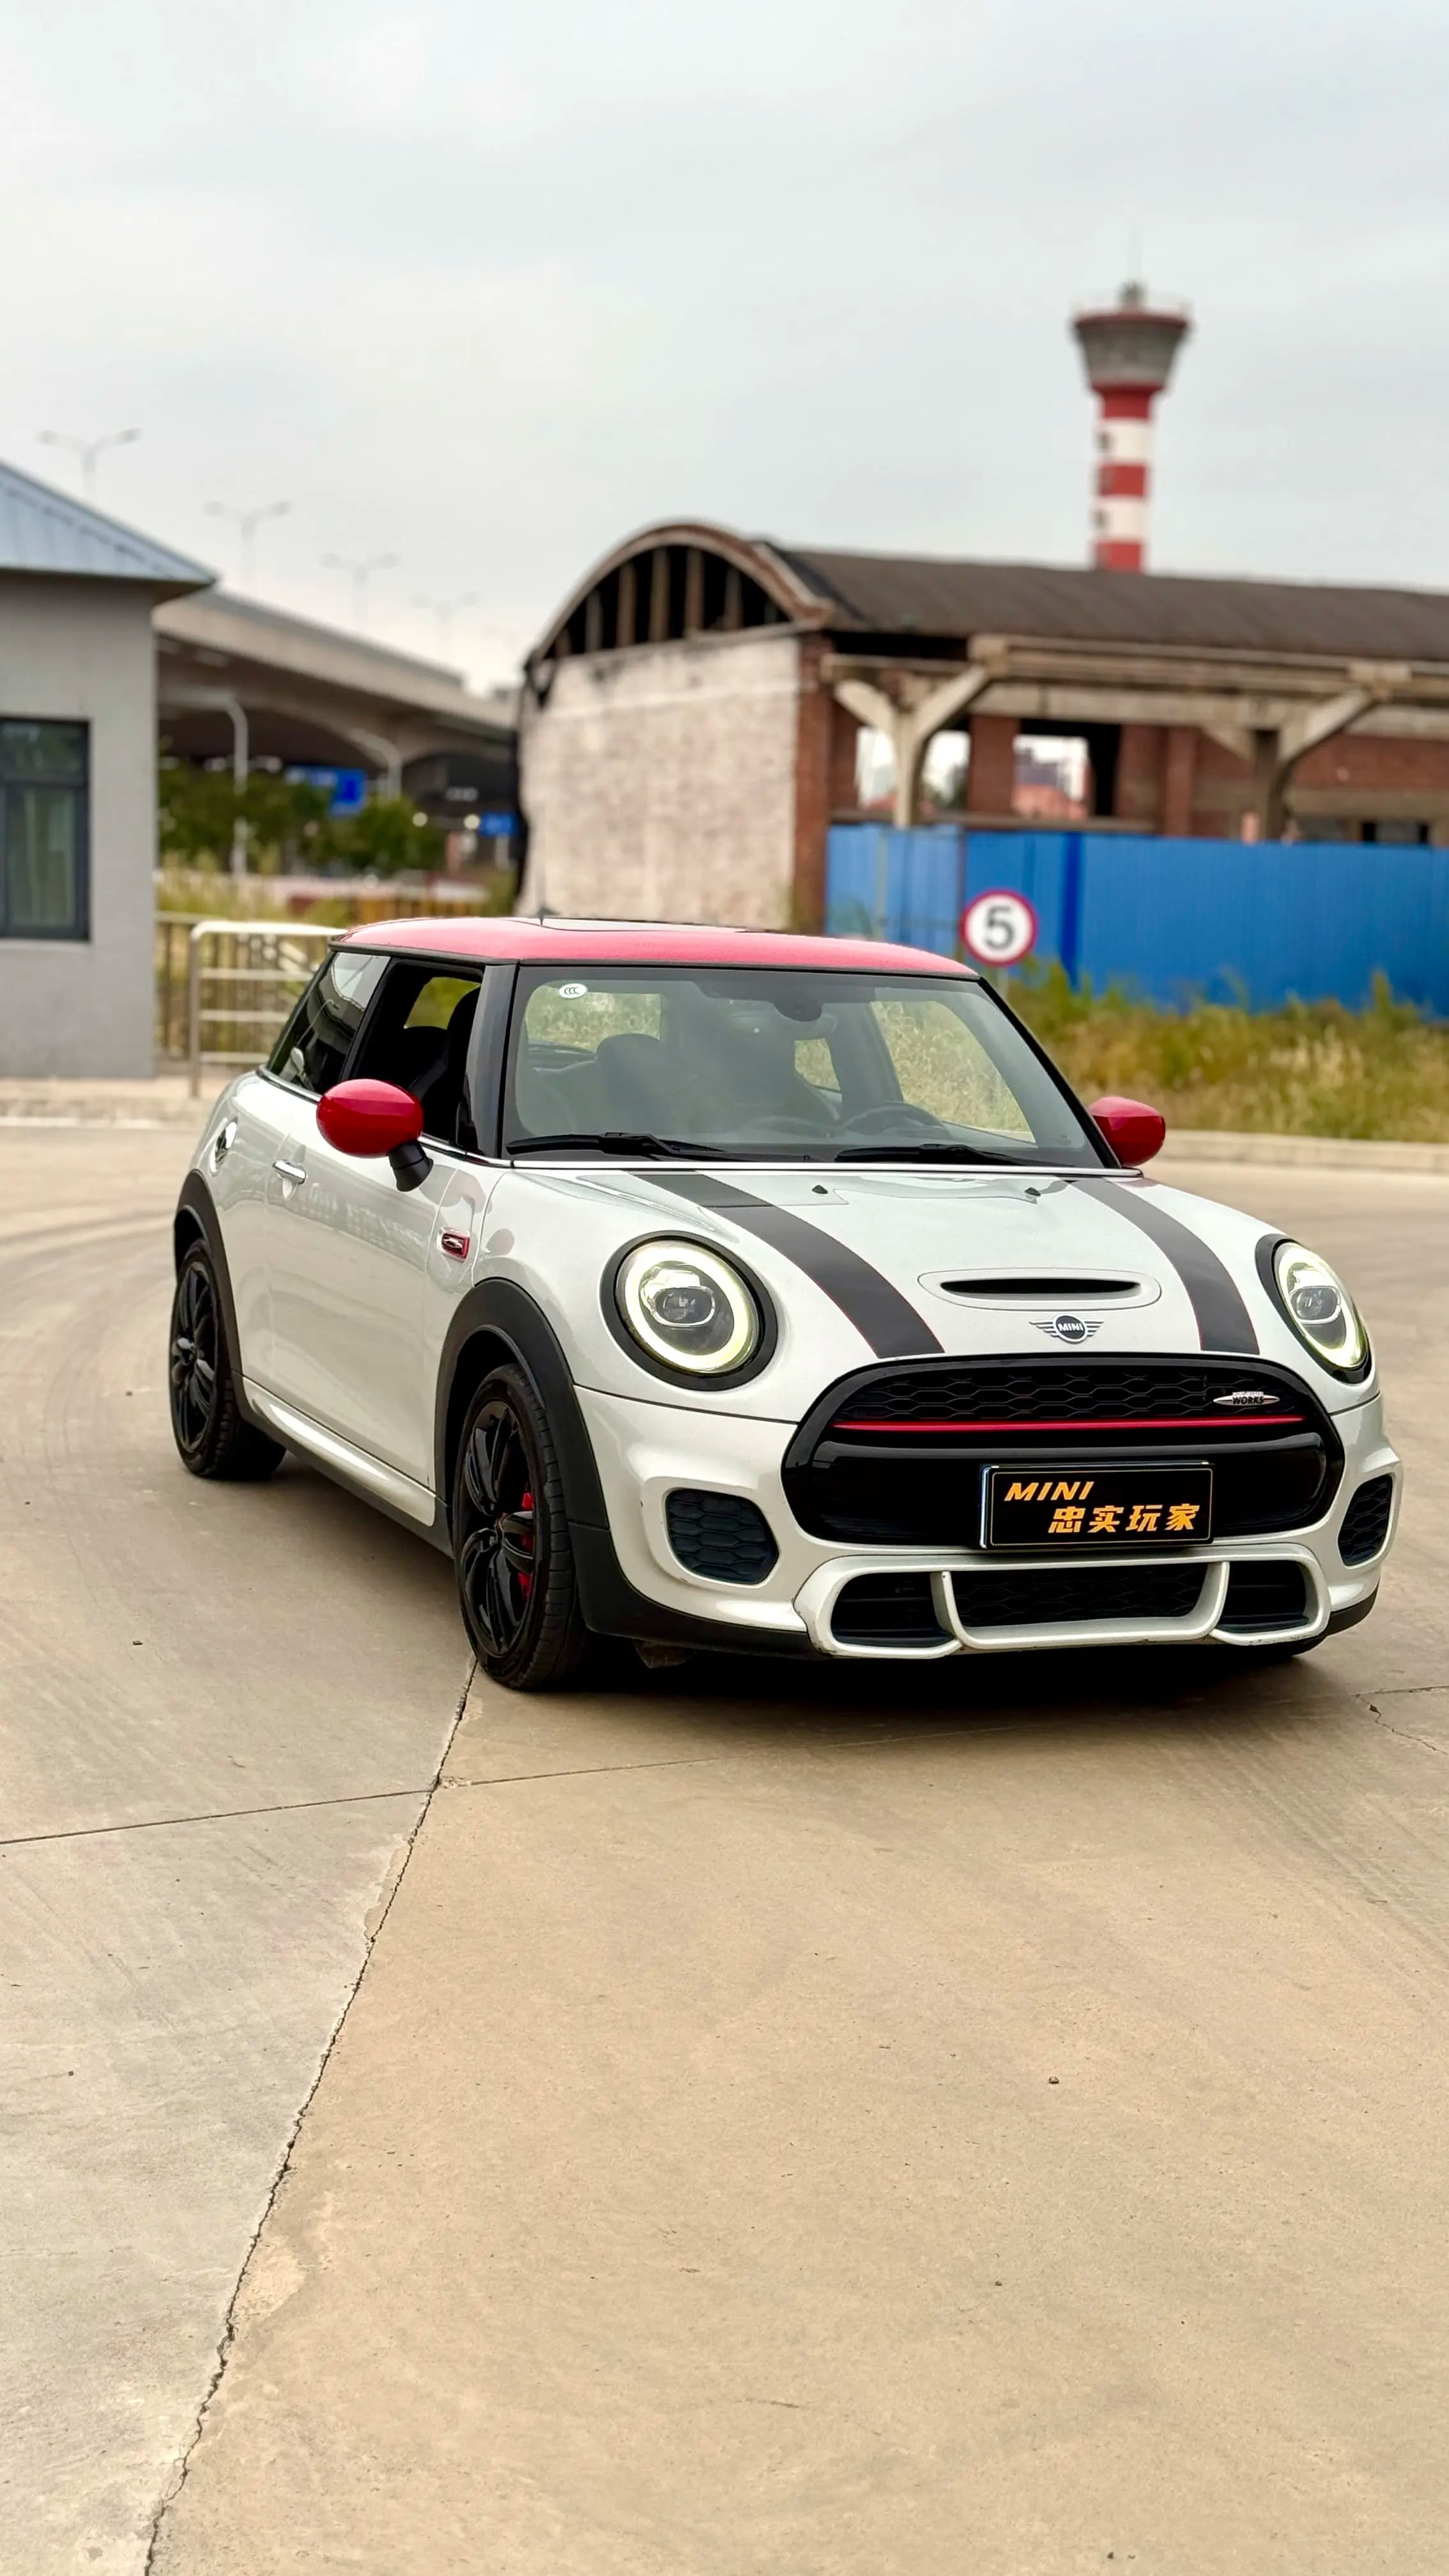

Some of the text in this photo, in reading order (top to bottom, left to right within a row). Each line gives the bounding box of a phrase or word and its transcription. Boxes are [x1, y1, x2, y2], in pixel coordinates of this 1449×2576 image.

[985, 905, 1016, 950] 5
[1057, 1322, 1084, 1331] MINI
[1232, 1396, 1264, 1405] WORKS
[1004, 1481, 1094, 1501] MINI
[1048, 1503, 1200, 1533] 忠实玩家
